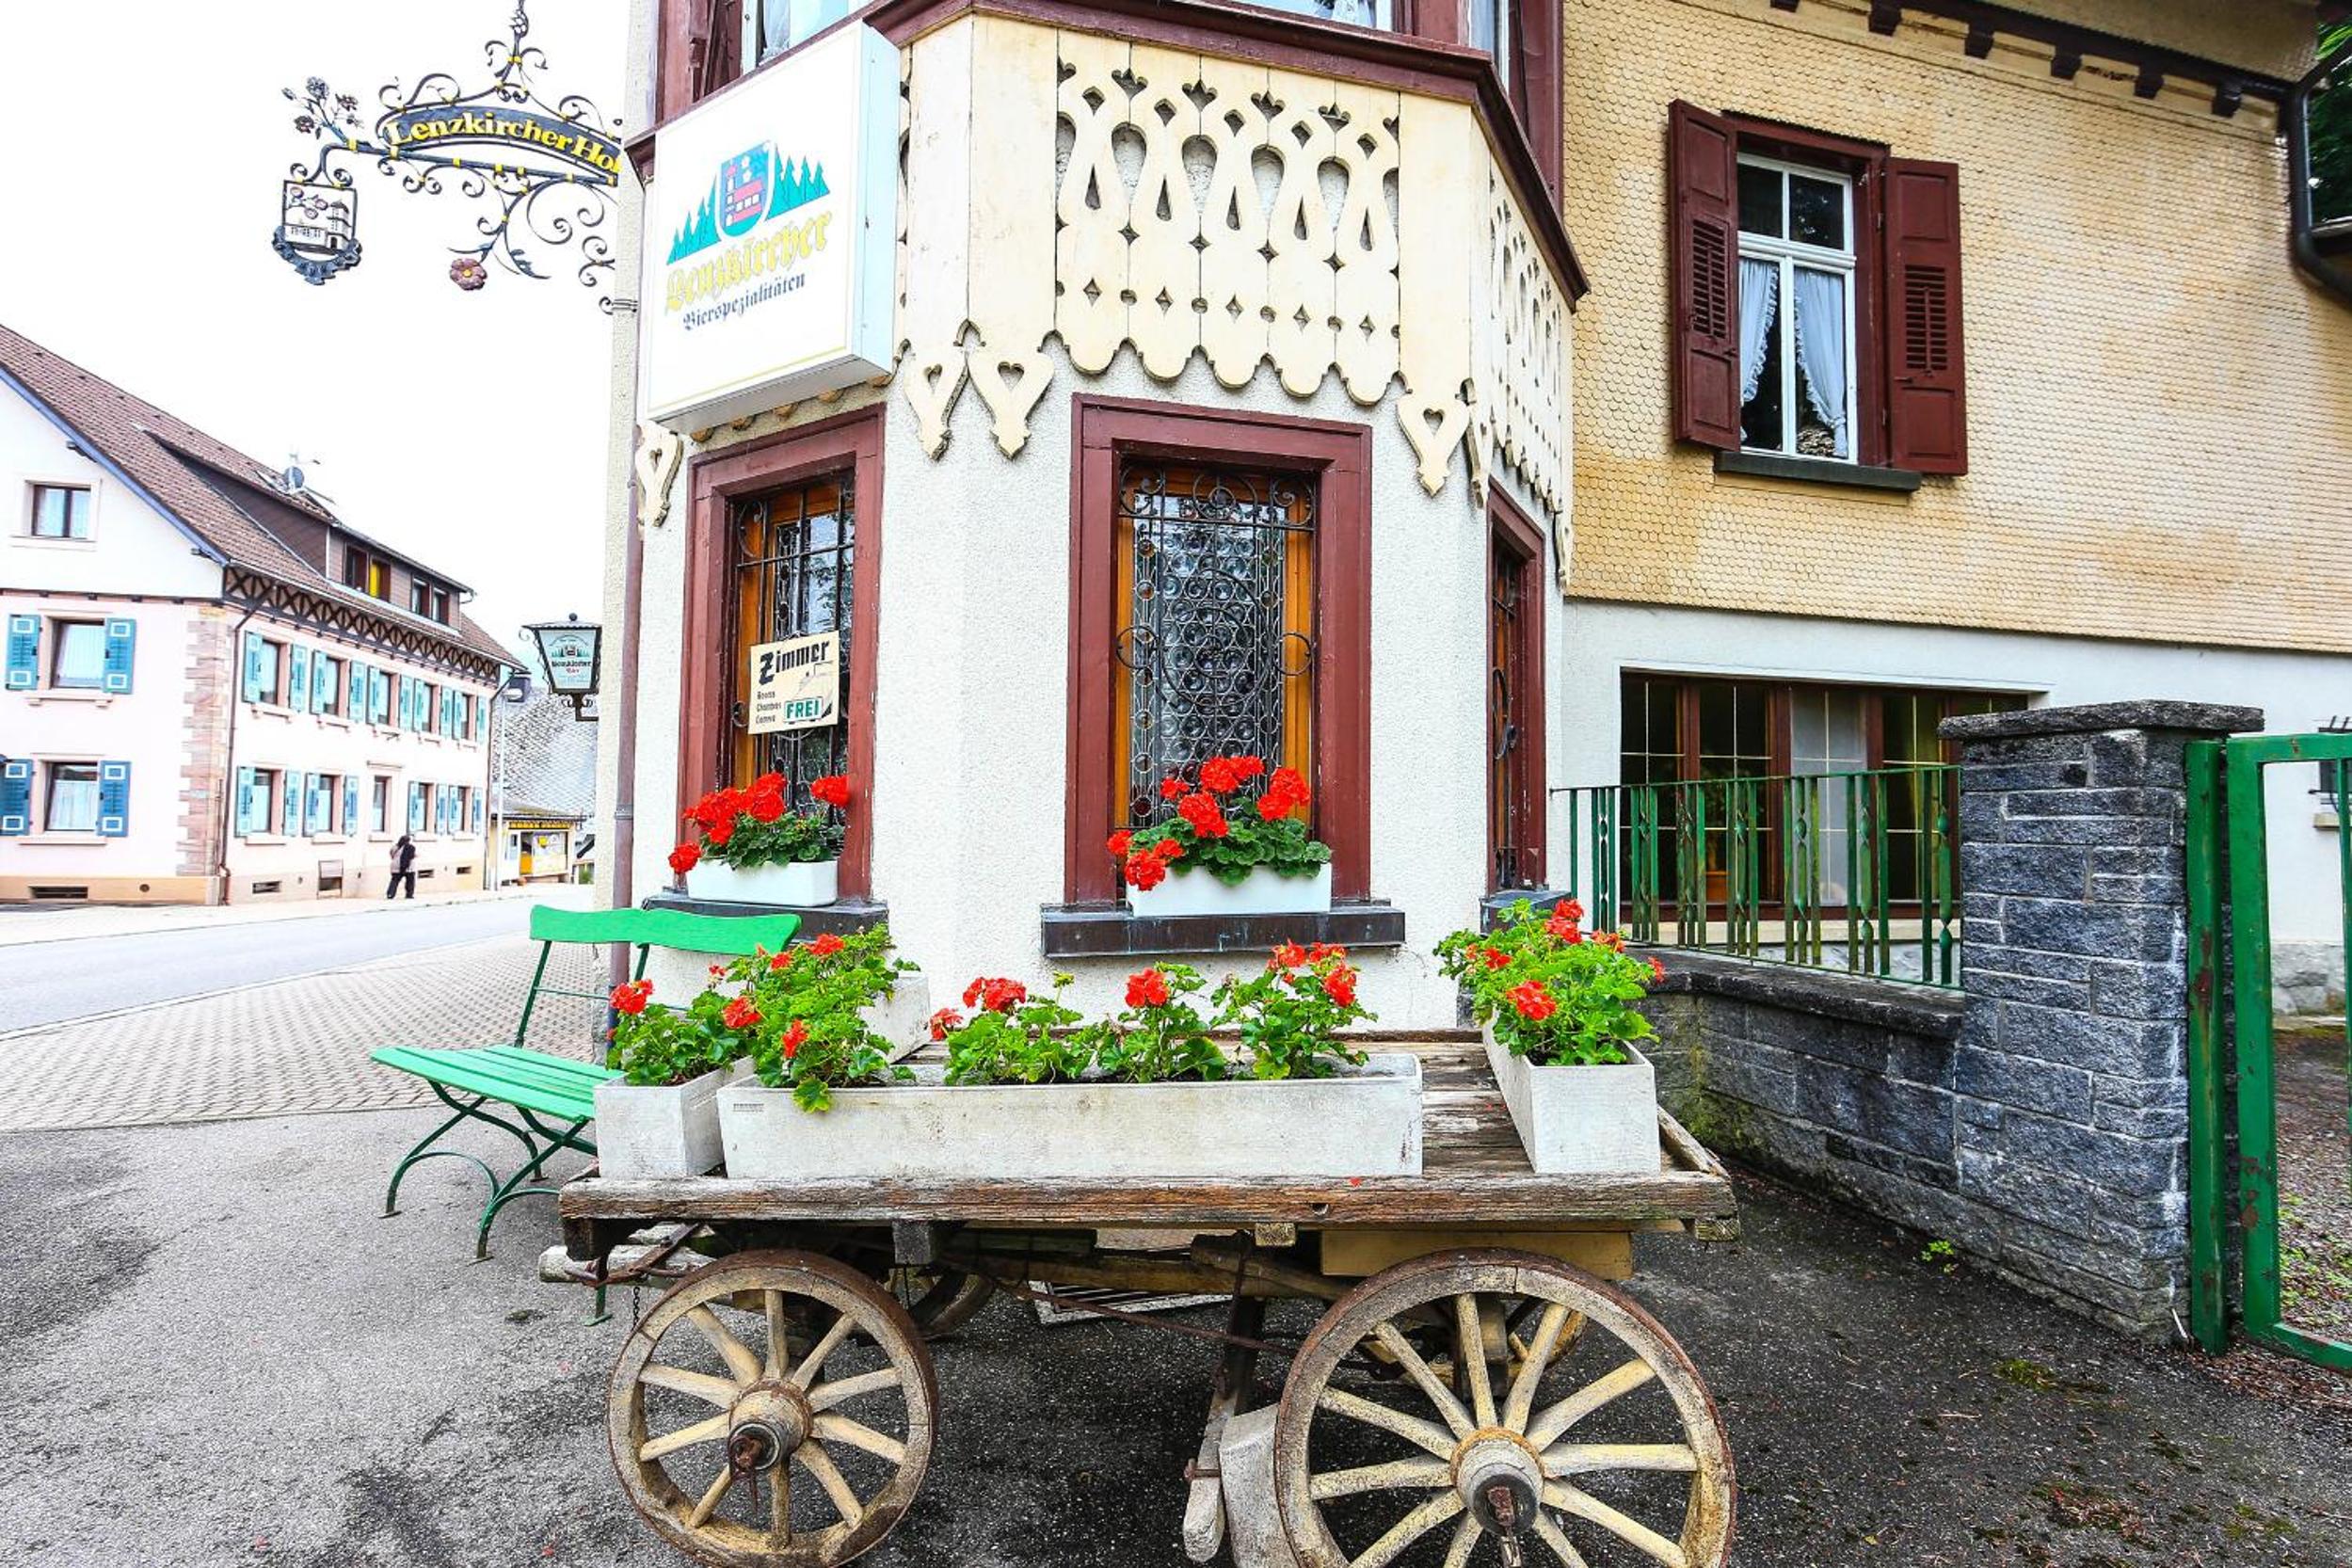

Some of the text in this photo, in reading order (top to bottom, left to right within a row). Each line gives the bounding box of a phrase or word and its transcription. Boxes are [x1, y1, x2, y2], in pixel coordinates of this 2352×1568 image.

[382, 112, 573, 151] Lenzkircher
[682, 272, 807, 331] Bierspezialitäten
[759, 641, 830, 686] Zimmer
[786, 699, 820, 719] FREI
